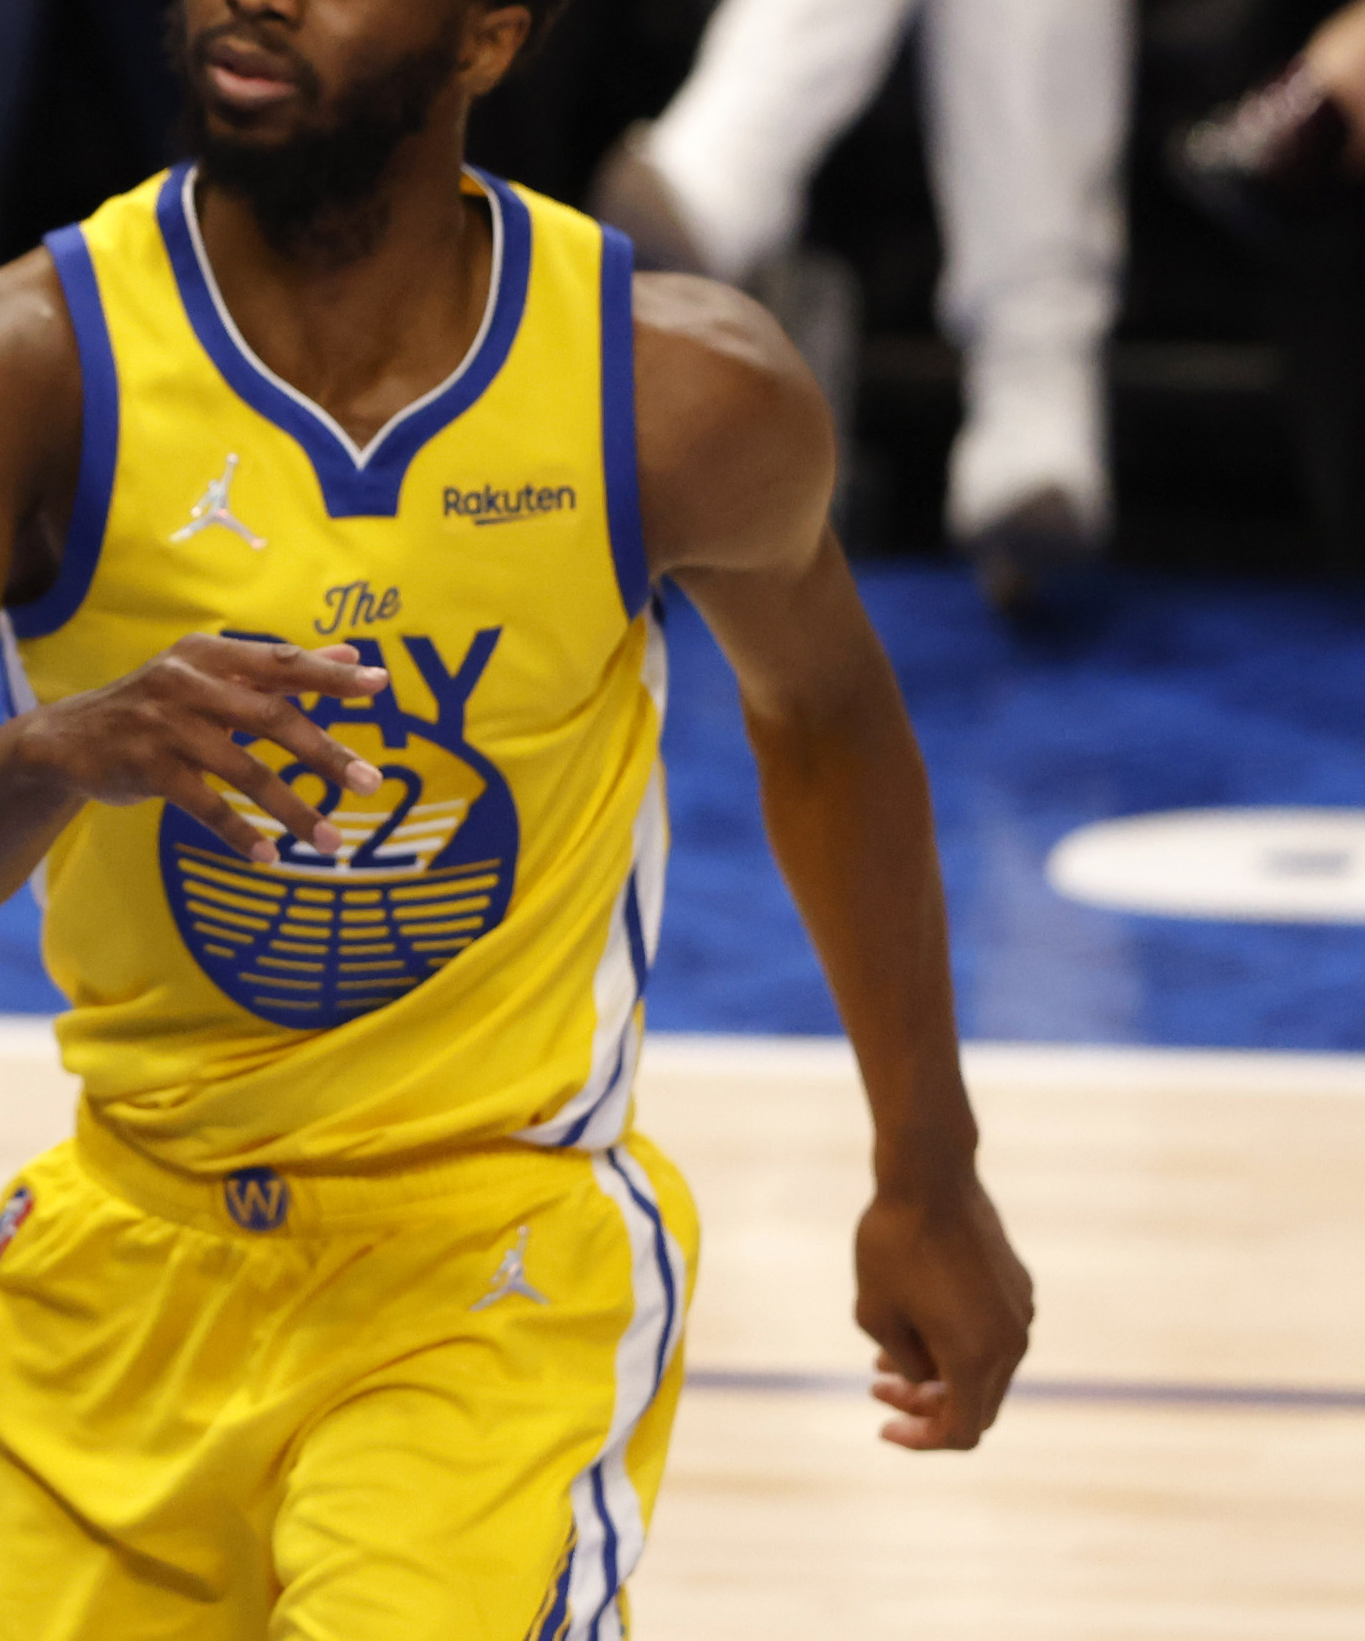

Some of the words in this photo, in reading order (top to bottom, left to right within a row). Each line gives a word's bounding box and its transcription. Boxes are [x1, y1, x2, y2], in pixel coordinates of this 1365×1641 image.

[442, 484, 577, 519] Rakuten
[314, 578, 403, 636] The
[219, 625, 503, 750] AY
[276, 762, 424, 868] 22
[226, 1178, 282, 1223] W
